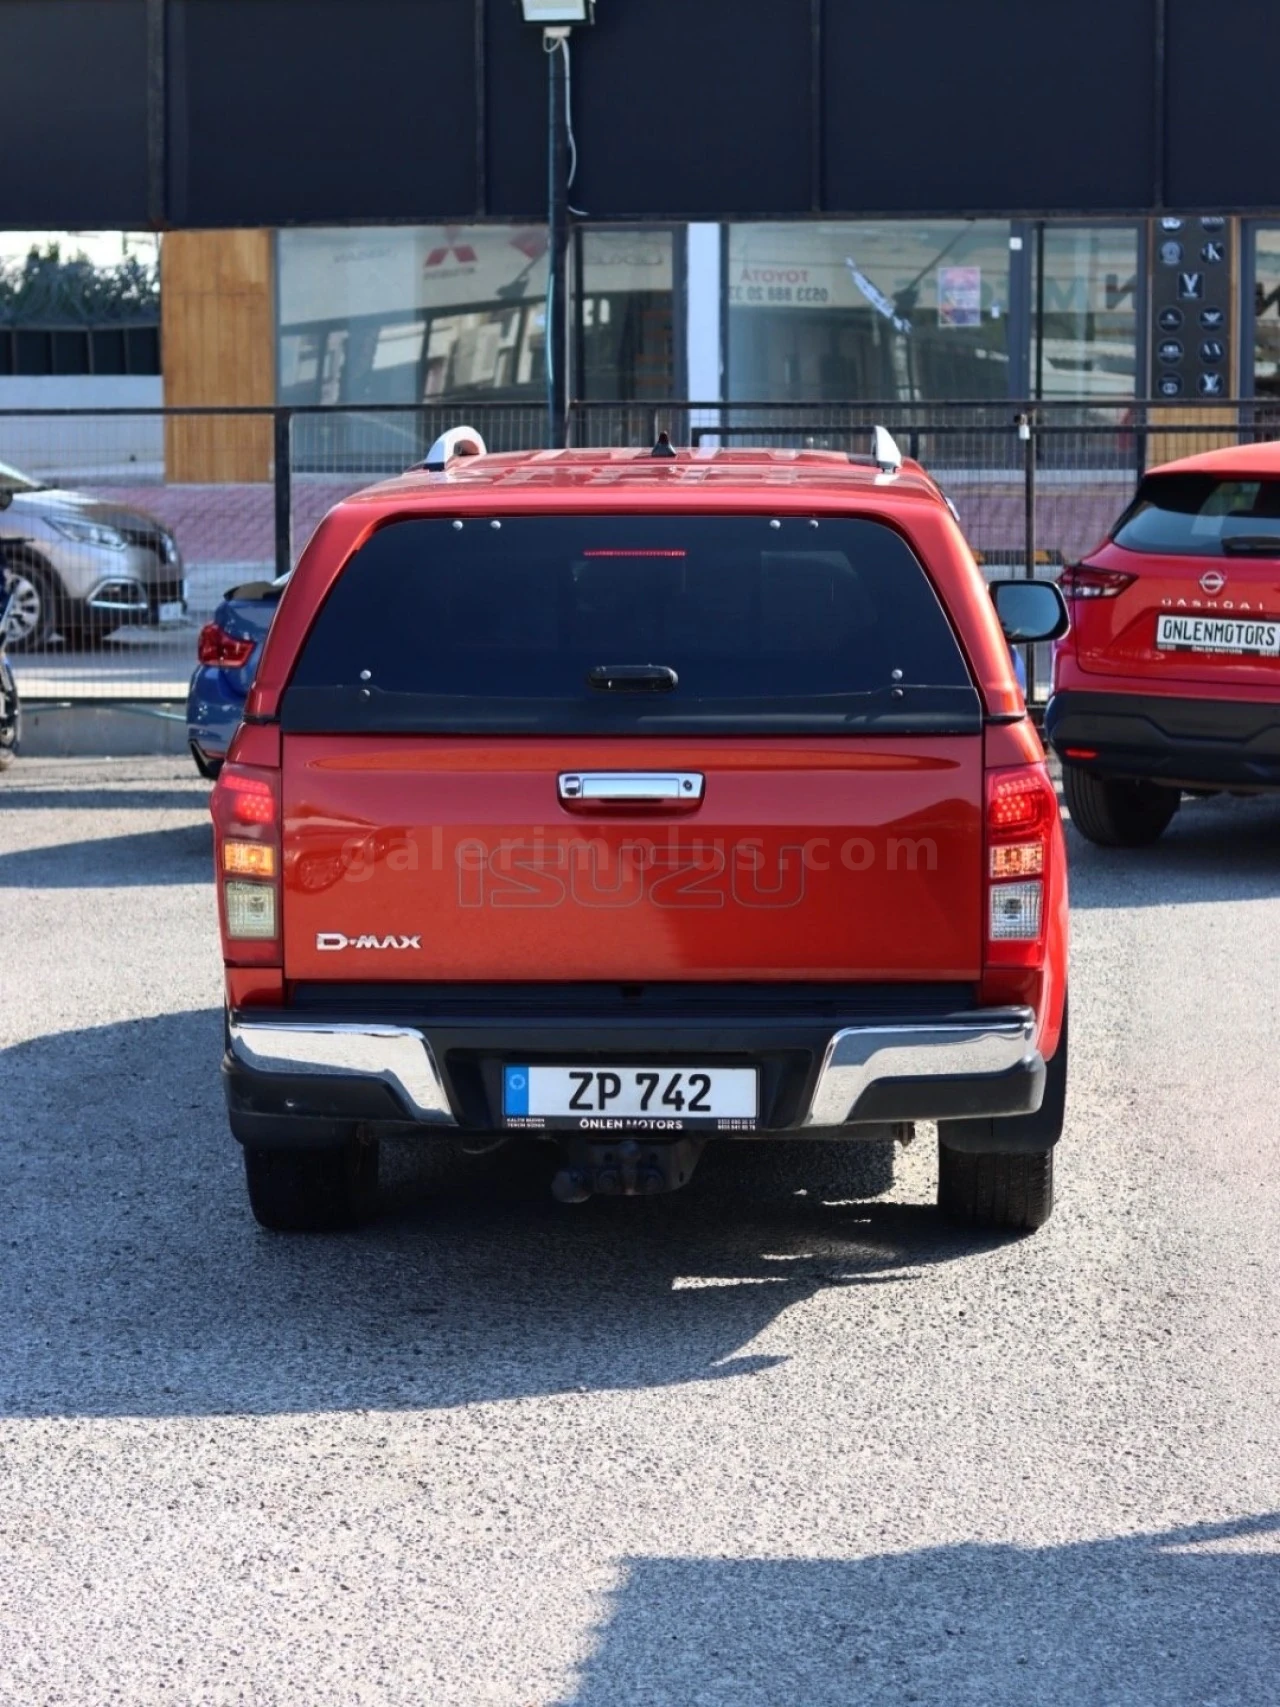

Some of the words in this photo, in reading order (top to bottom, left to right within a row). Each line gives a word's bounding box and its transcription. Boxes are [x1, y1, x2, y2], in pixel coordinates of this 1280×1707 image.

[1163, 619, 1276, 647] ONLENMOTORS
[457, 845, 806, 909] ISUZU
[316, 933, 421, 952] D-MAX
[569, 1072, 621, 1110] ZP
[636, 1073, 711, 1112] 742
[579, 1118, 623, 1129] ÖNLEN
